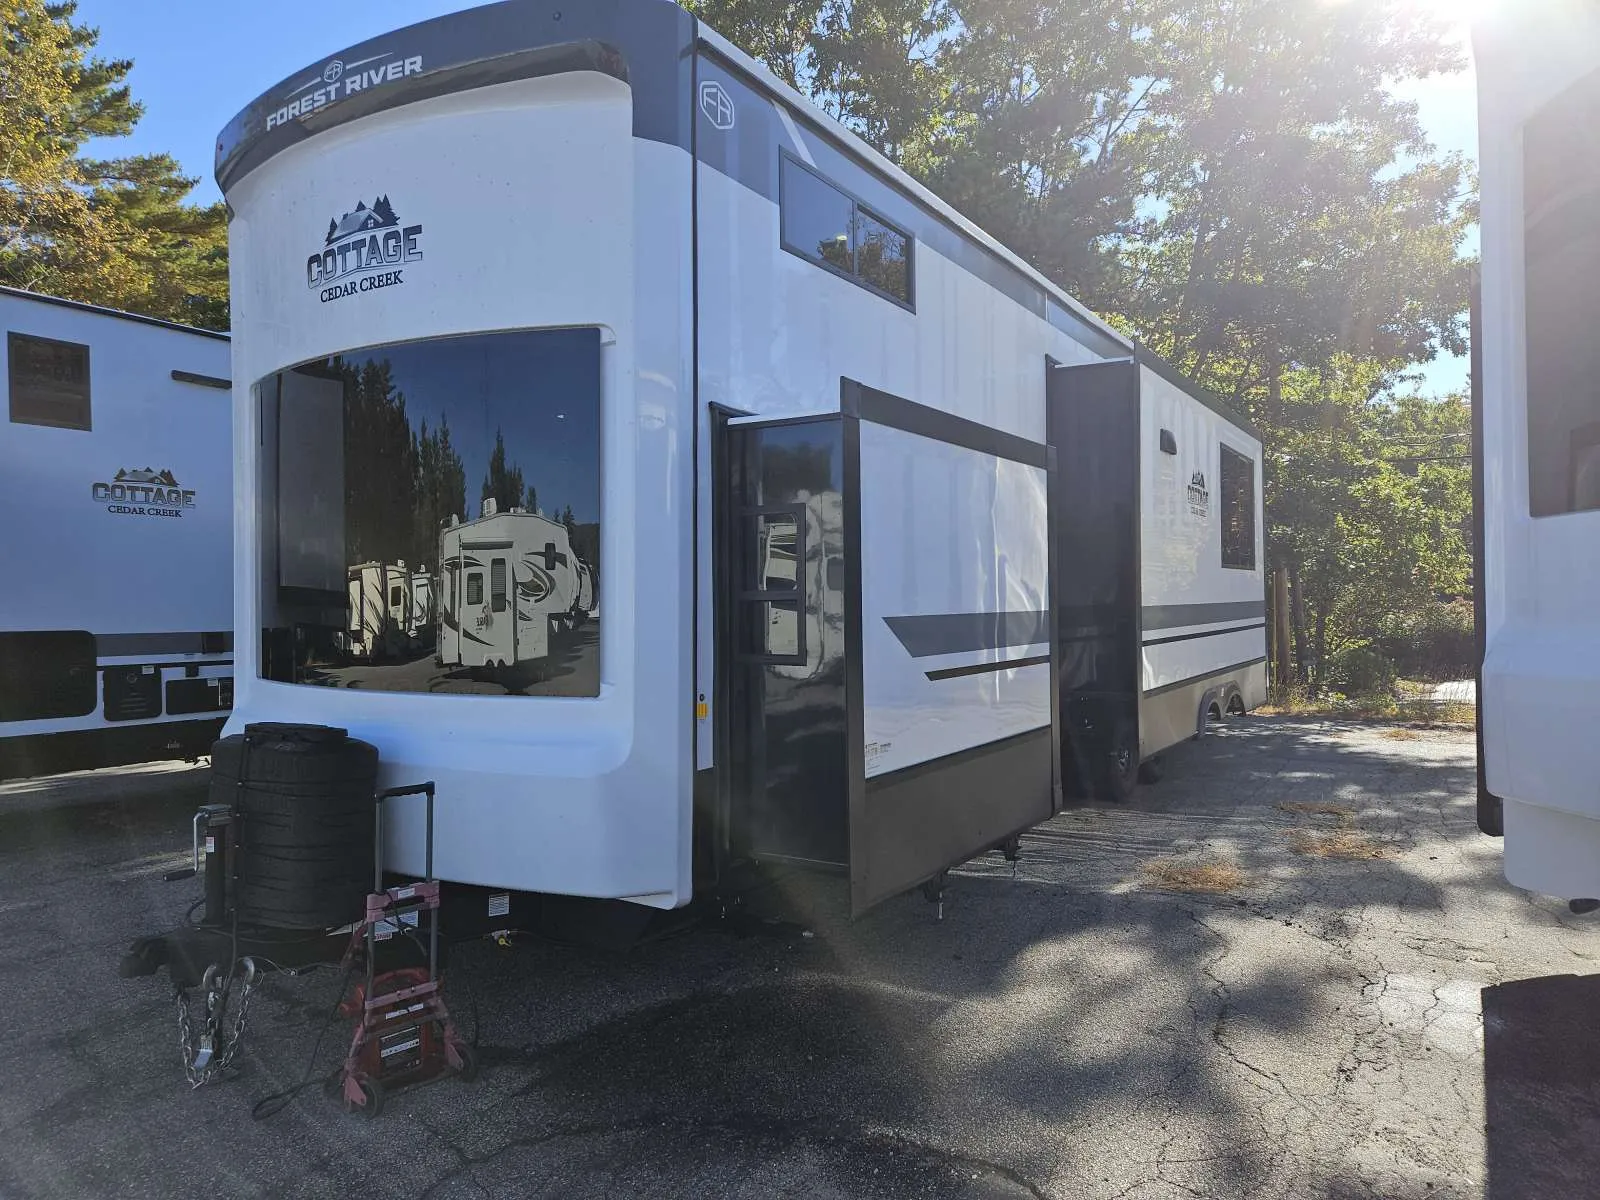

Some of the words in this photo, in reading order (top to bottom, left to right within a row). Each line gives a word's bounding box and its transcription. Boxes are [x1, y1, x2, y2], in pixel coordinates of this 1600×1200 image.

[266, 82, 341, 131] FOREST
[345, 55, 423, 95] RIVER
[307, 224, 423, 289] COTTAGE
[320, 281, 358, 303] CEDAR
[360, 269, 404, 292] CREEK
[92, 482, 196, 509] COTTAGE
[107, 504, 146, 515] CEDAR
[147, 507, 182, 517] CREEK
